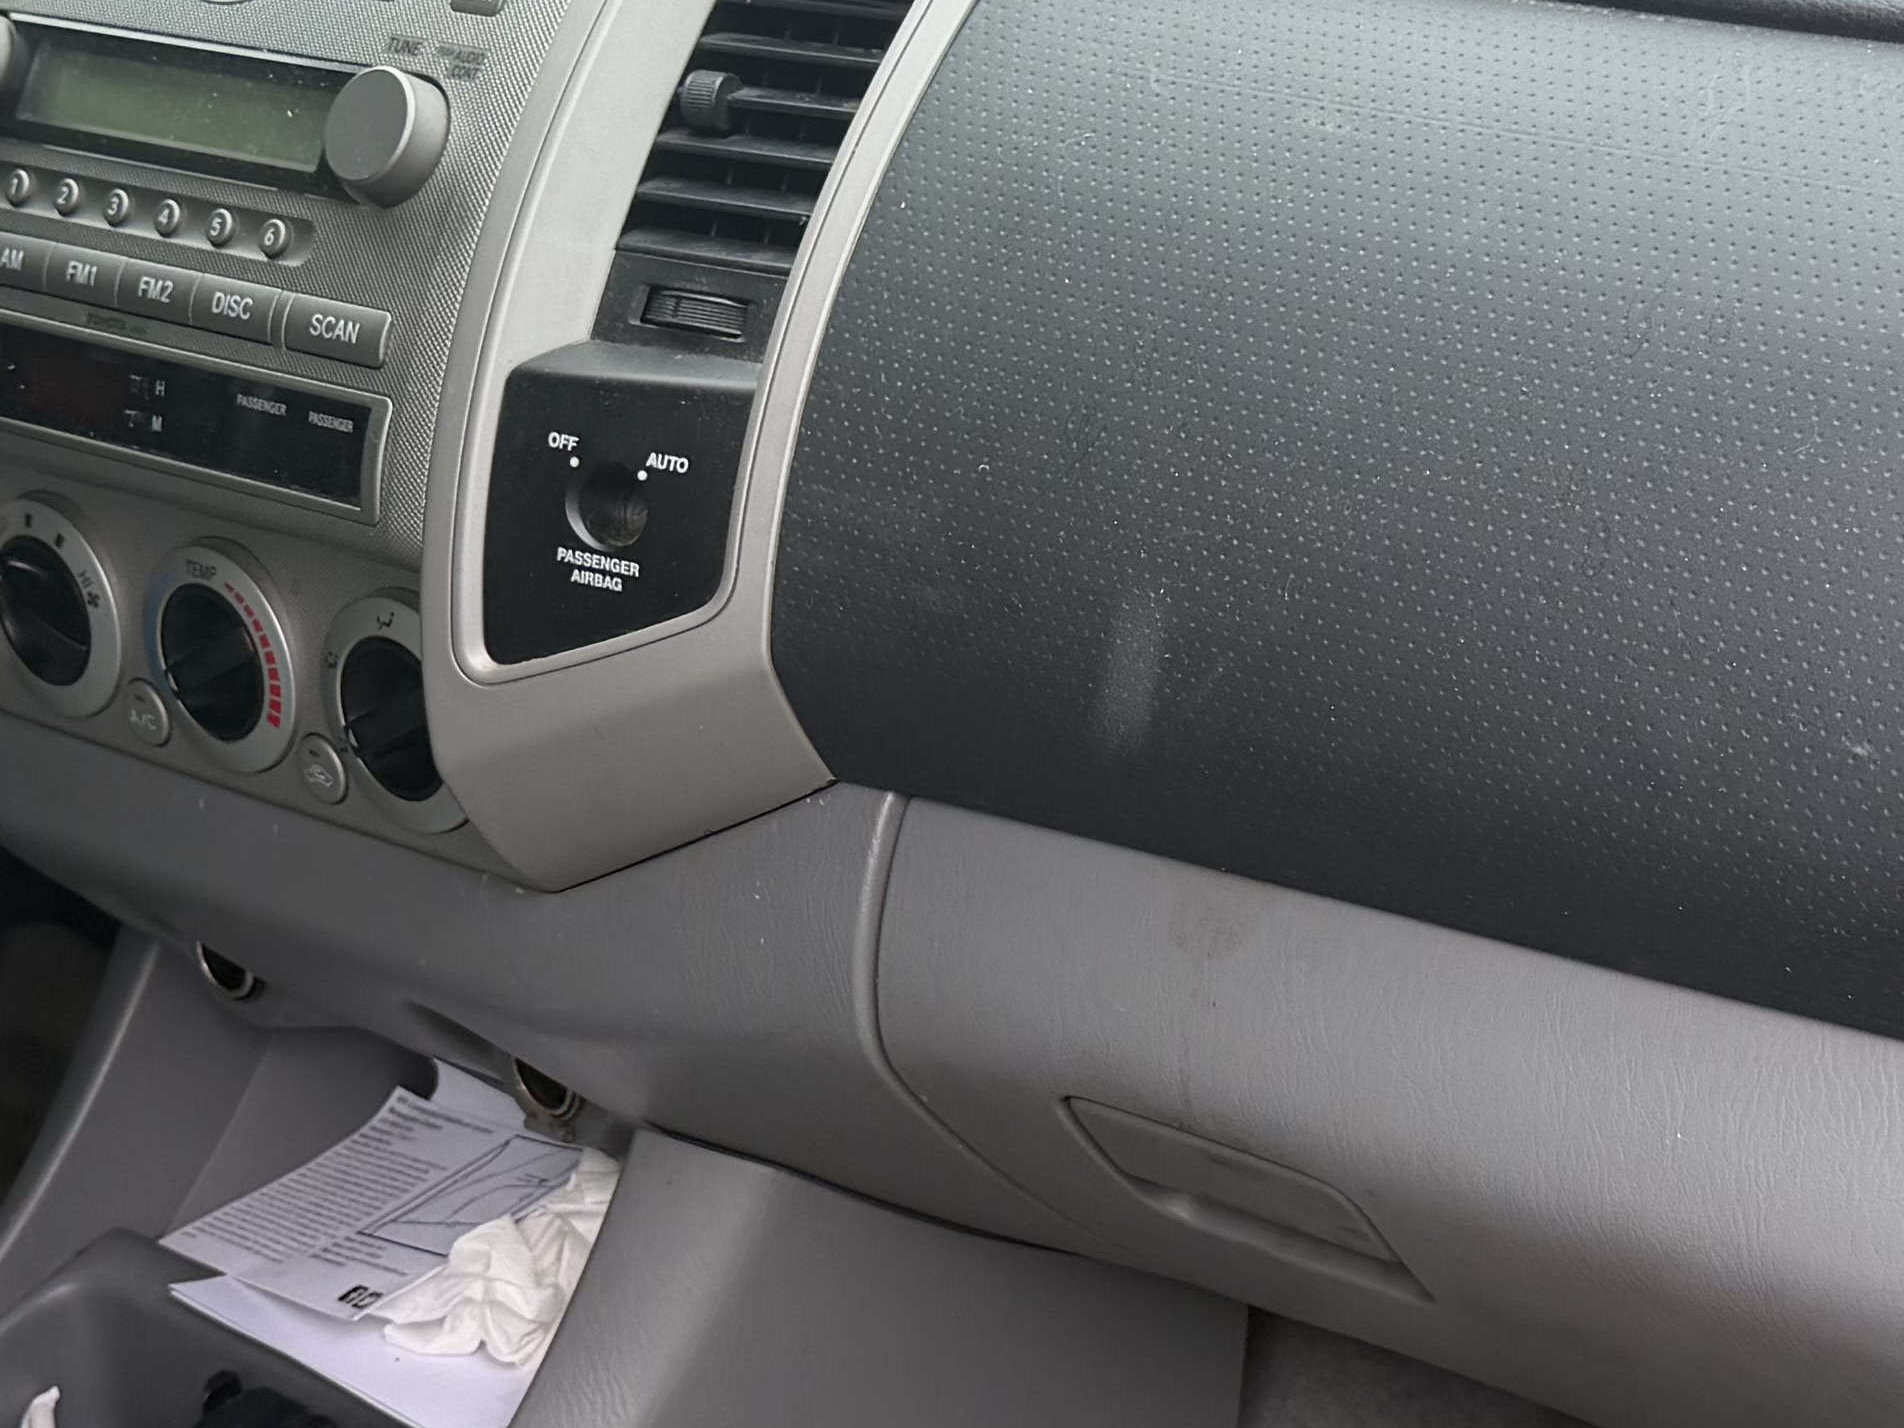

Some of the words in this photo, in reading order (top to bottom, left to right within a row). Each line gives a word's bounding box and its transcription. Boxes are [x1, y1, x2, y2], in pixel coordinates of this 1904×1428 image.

[387, 35, 428, 57] TUNE
[10, 177, 20, 192] 1
[57, 189, 69, 205] 2
[107, 199, 120, 215] 3
[157, 209, 170, 225] 4
[210, 219, 222, 236] 5
[263, 229, 276, 246] 6
[0, 247, 25, 272] AM
[65, 260, 99, 288] FM1
[137, 275, 174, 304] FM2
[211, 291, 254, 320] DISC
[309, 313, 361, 345] SCAN
[155, 379, 166, 397] H
[236, 393, 288, 417] PASSENGER
[308, 410, 354, 434] PASSENGER
[547, 431, 580, 451] OFF
[646, 452, 690, 474] AUTO
[185, 558, 217, 582] TEMP
[556, 546, 641, 578] PASSENGER
[570, 569, 624, 592] AIRBAG
[129, 708, 157, 732] A/C
